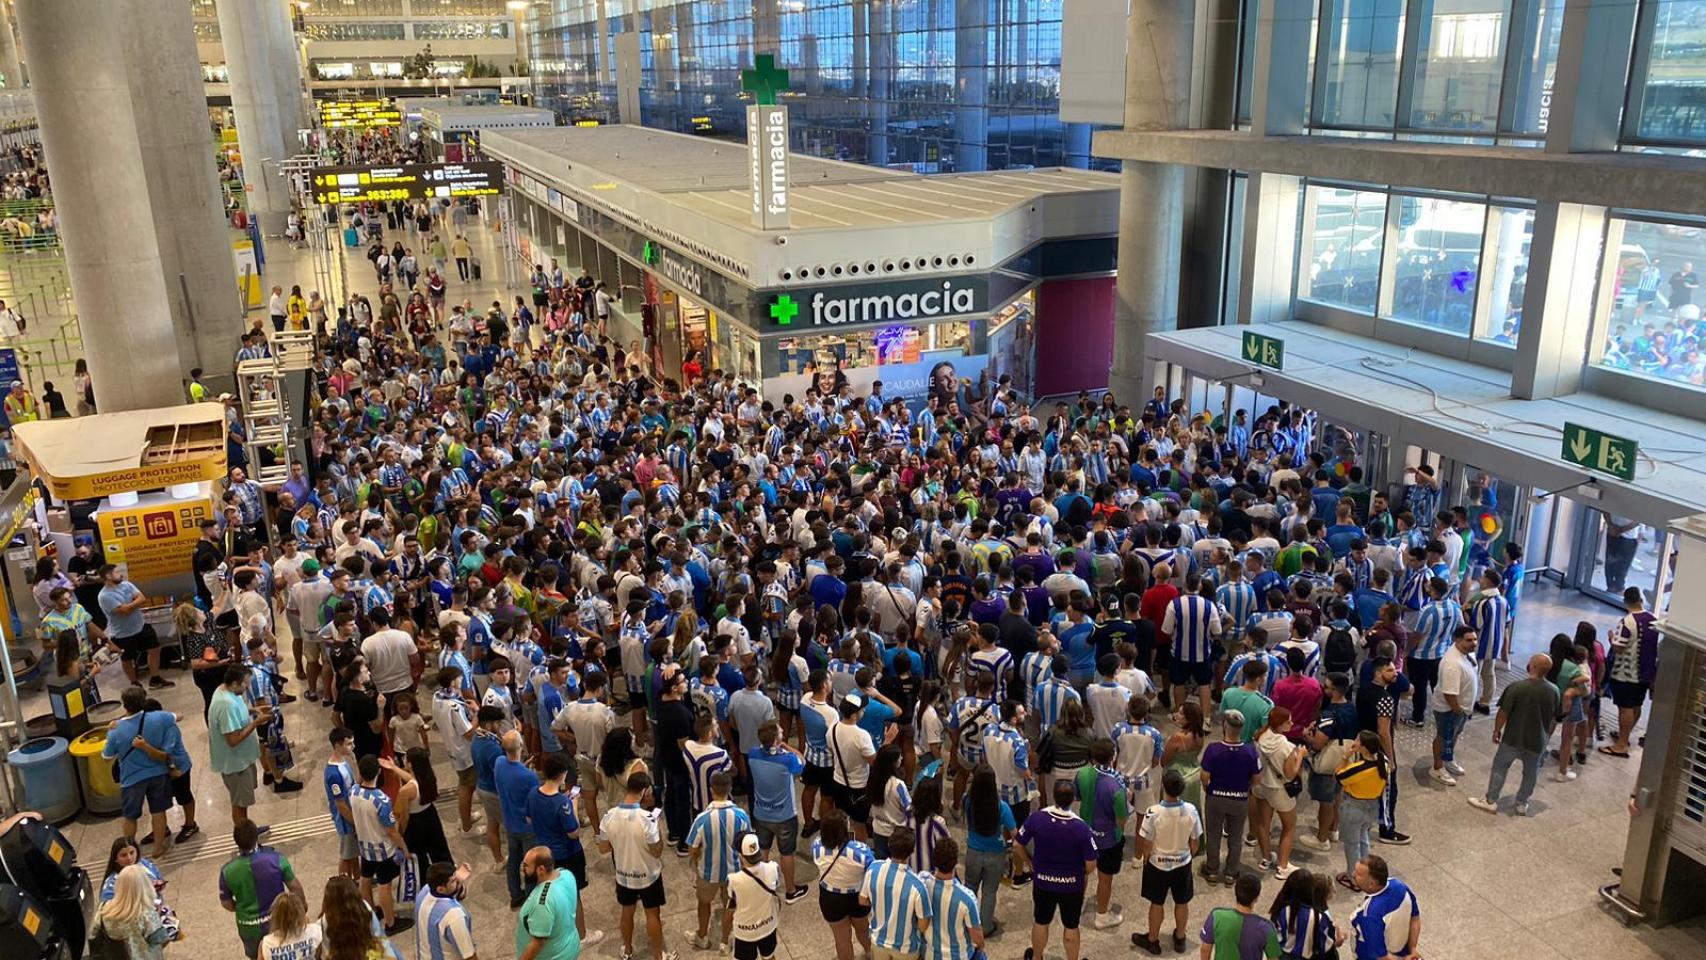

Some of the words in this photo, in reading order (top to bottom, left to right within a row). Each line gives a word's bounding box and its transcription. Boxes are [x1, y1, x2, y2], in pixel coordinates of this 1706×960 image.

[750, 111, 760, 213] farmacia
[765, 111, 787, 215] farmacia
[662, 249, 701, 296] farmacia
[812, 281, 974, 325] farmacia
[91, 473, 136, 485] LUGGAGE
[140, 463, 201, 478] PROTECTION
[158, 471, 201, 484] EQUIPAJES
